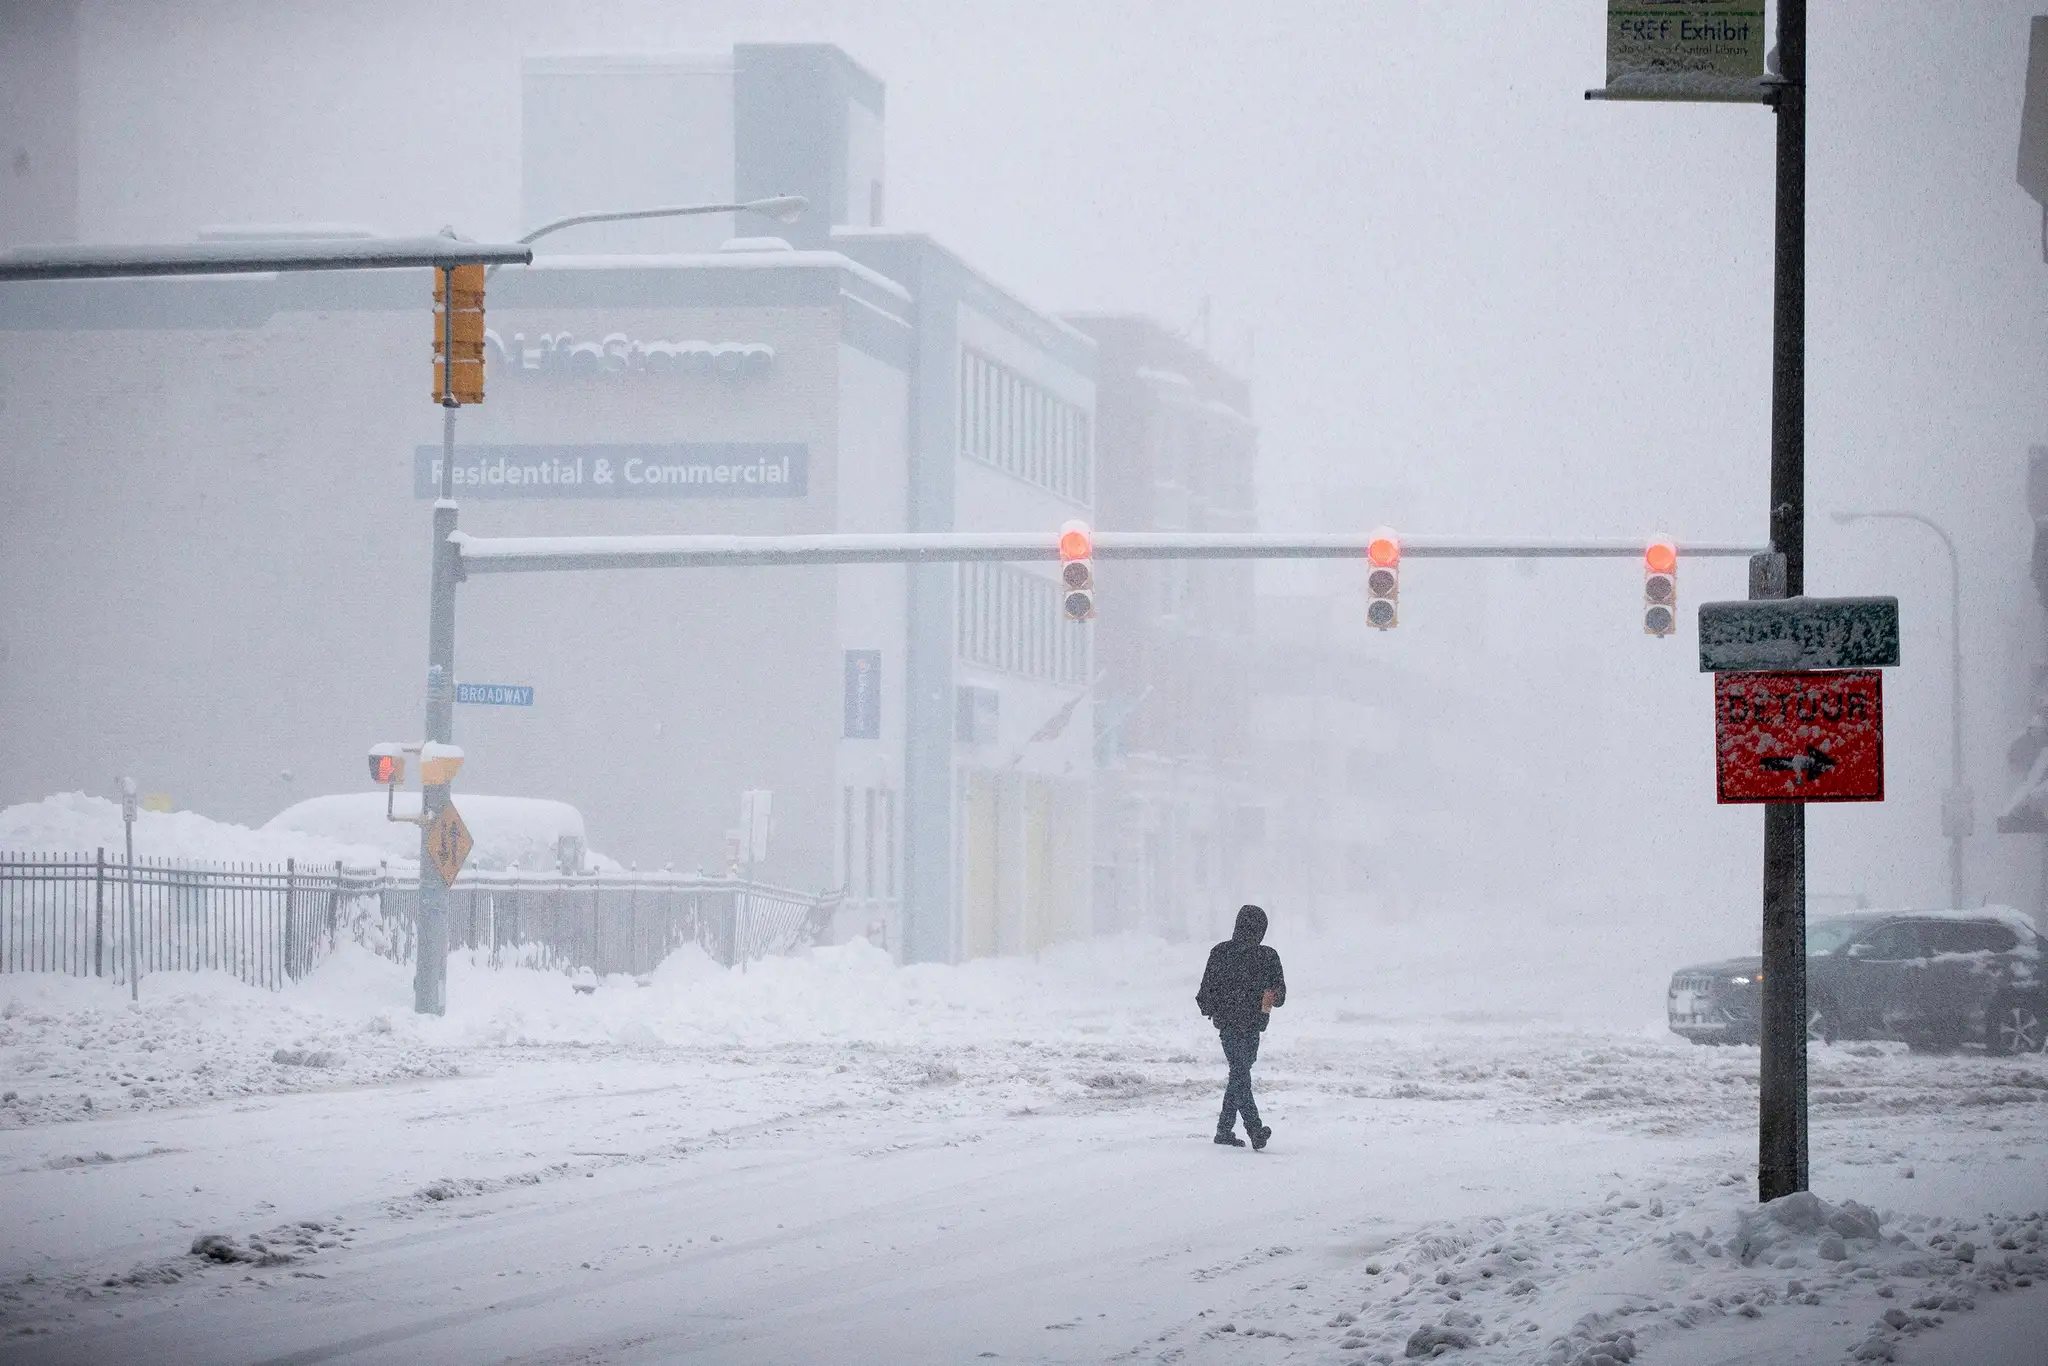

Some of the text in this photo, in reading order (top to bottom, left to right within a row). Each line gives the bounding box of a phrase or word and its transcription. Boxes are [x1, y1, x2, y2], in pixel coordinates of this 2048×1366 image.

[1681, 19, 1749, 41] Exhibit
[593, 458, 615, 485] &
[623, 456, 790, 485] Commercial
[460, 686, 530, 704] BROADWAY
[1728, 692, 1868, 723] DETOUR
